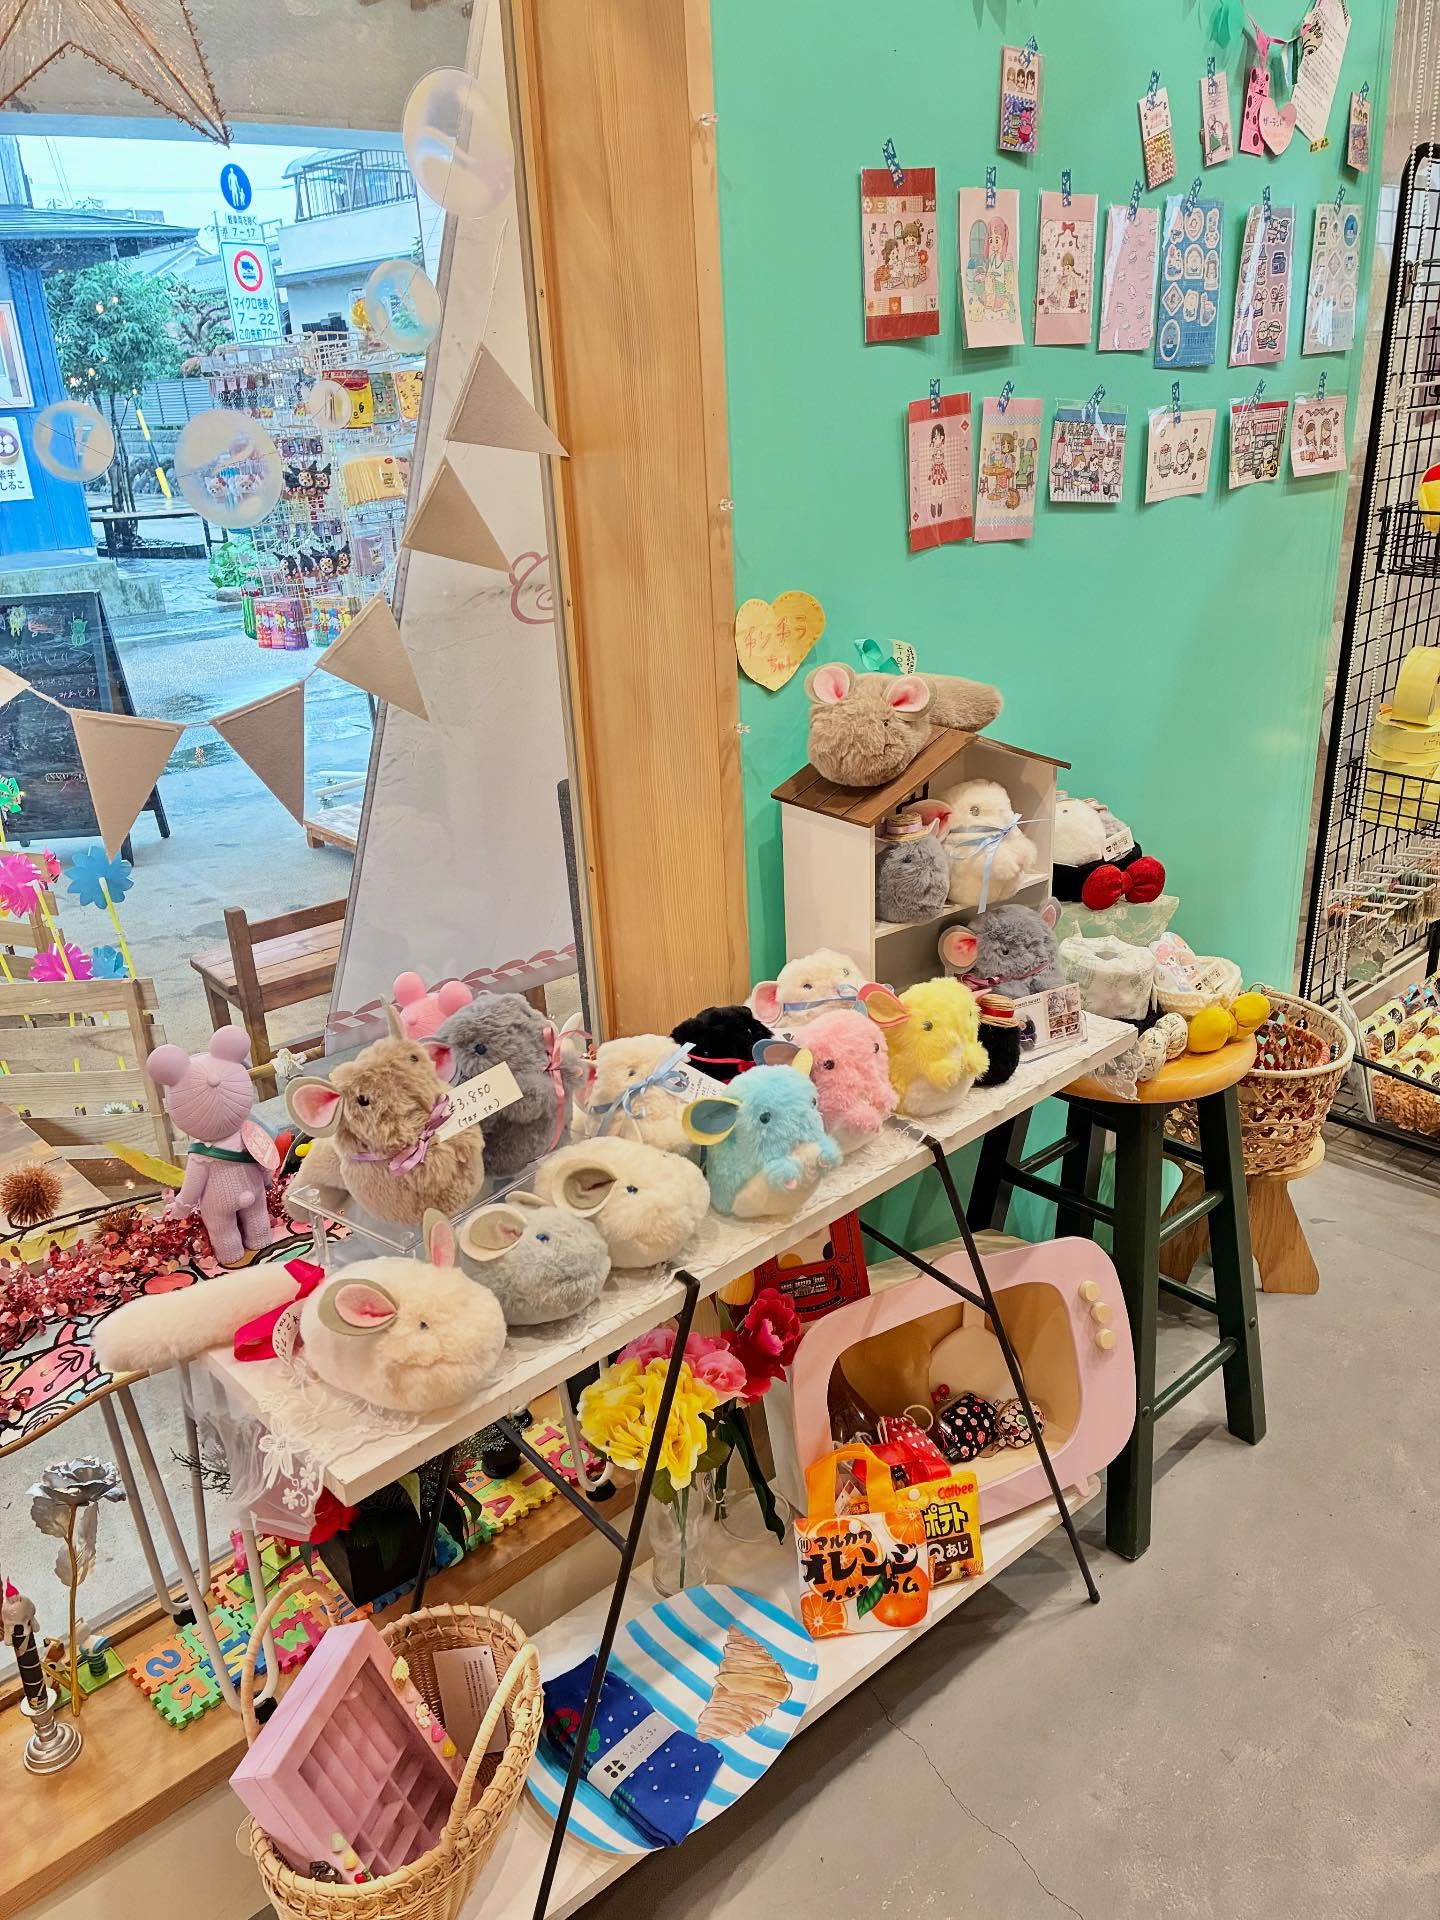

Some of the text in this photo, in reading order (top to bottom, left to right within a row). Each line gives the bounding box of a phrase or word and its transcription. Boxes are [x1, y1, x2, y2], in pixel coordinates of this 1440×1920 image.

[237, 312, 275, 326] 7-22
[937, 1483, 974, 1500] Calbee
[922, 1502, 968, 1539] ポテト
[813, 1530, 873, 1550] マルカワ
[801, 1543, 919, 1585] オレンジ
[883, 1575, 920, 1595] ガム
